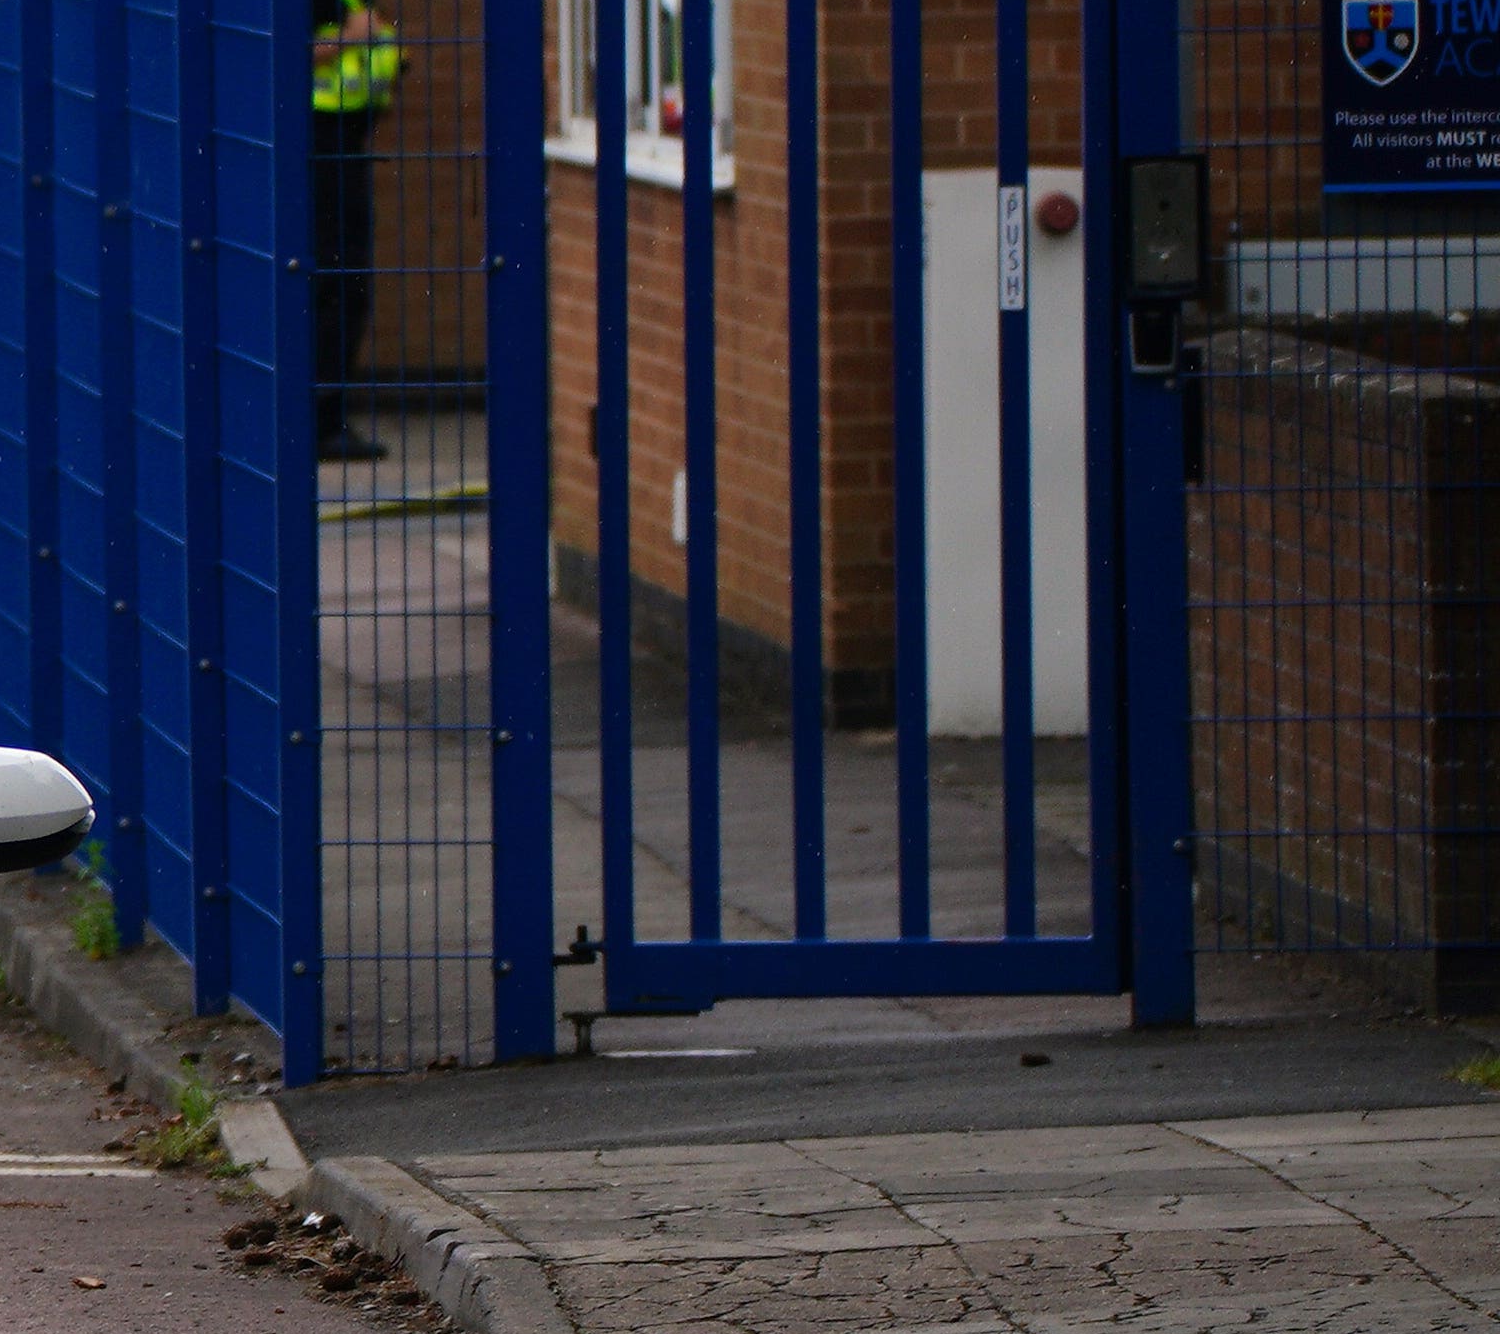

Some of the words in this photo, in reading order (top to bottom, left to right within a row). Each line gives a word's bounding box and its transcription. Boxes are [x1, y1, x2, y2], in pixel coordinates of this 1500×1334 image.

[1435, 38, 1500, 77] AC
[1335, 110, 1385, 126] Please
[1389, 113, 1417, 126] use
[1421, 109, 1448, 125] the
[1352, 132, 1373, 148] All
[1377, 132, 1434, 147] visitors
[1436, 130, 1487, 147] MUST
[1426, 155, 1442, 169] at
[1445, 153, 1472, 168] the
[1006, 196, 1020, 296] PUSH
